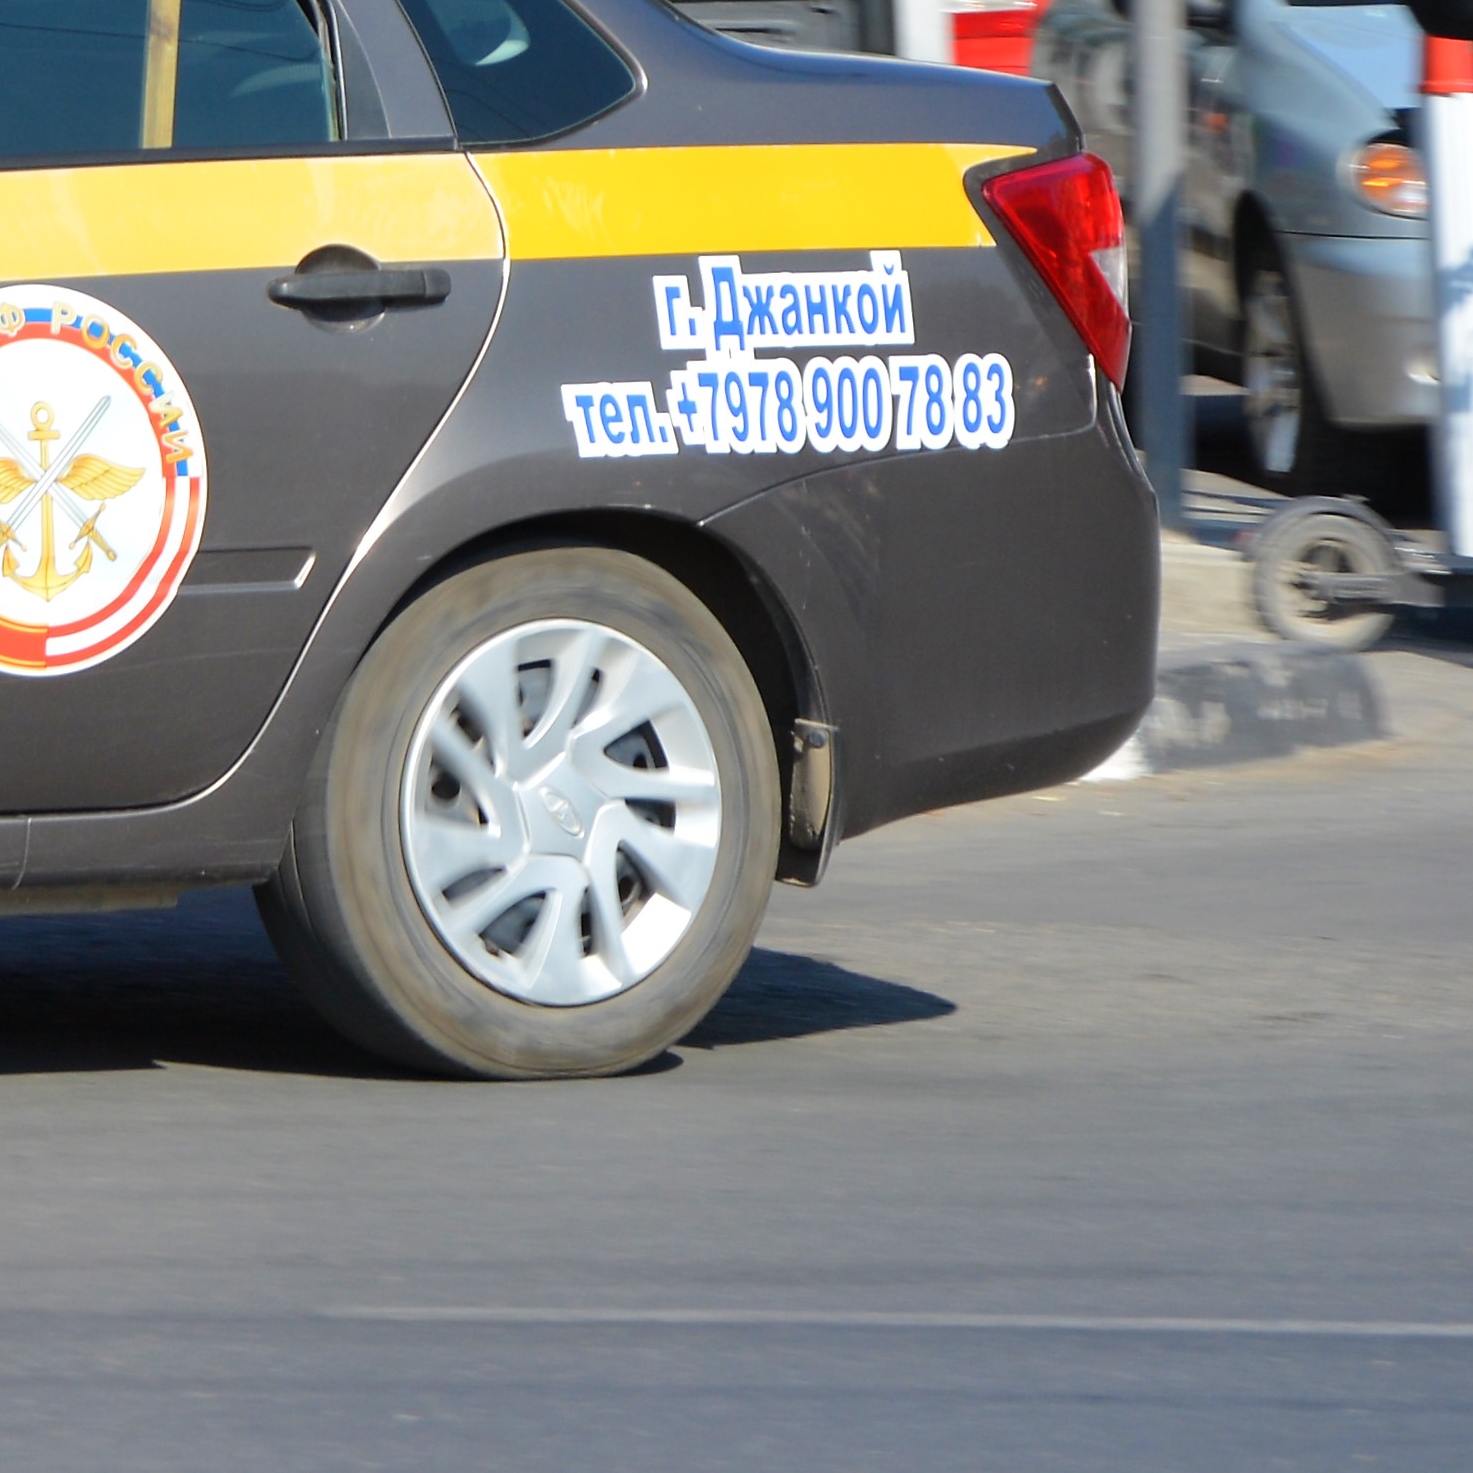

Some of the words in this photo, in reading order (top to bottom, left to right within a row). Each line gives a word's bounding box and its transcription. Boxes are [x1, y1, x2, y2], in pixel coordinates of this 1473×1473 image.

[658, 280, 699, 342] г.
[705, 257, 910, 355] Джанкой
[51, 302, 194, 464] РОССИИ
[569, 388, 672, 450] тел.
[672, 364, 801, 448] +7978
[808, 361, 887, 445] 900
[894, 360, 950, 443] 78
[958, 357, 1011, 442] 83
